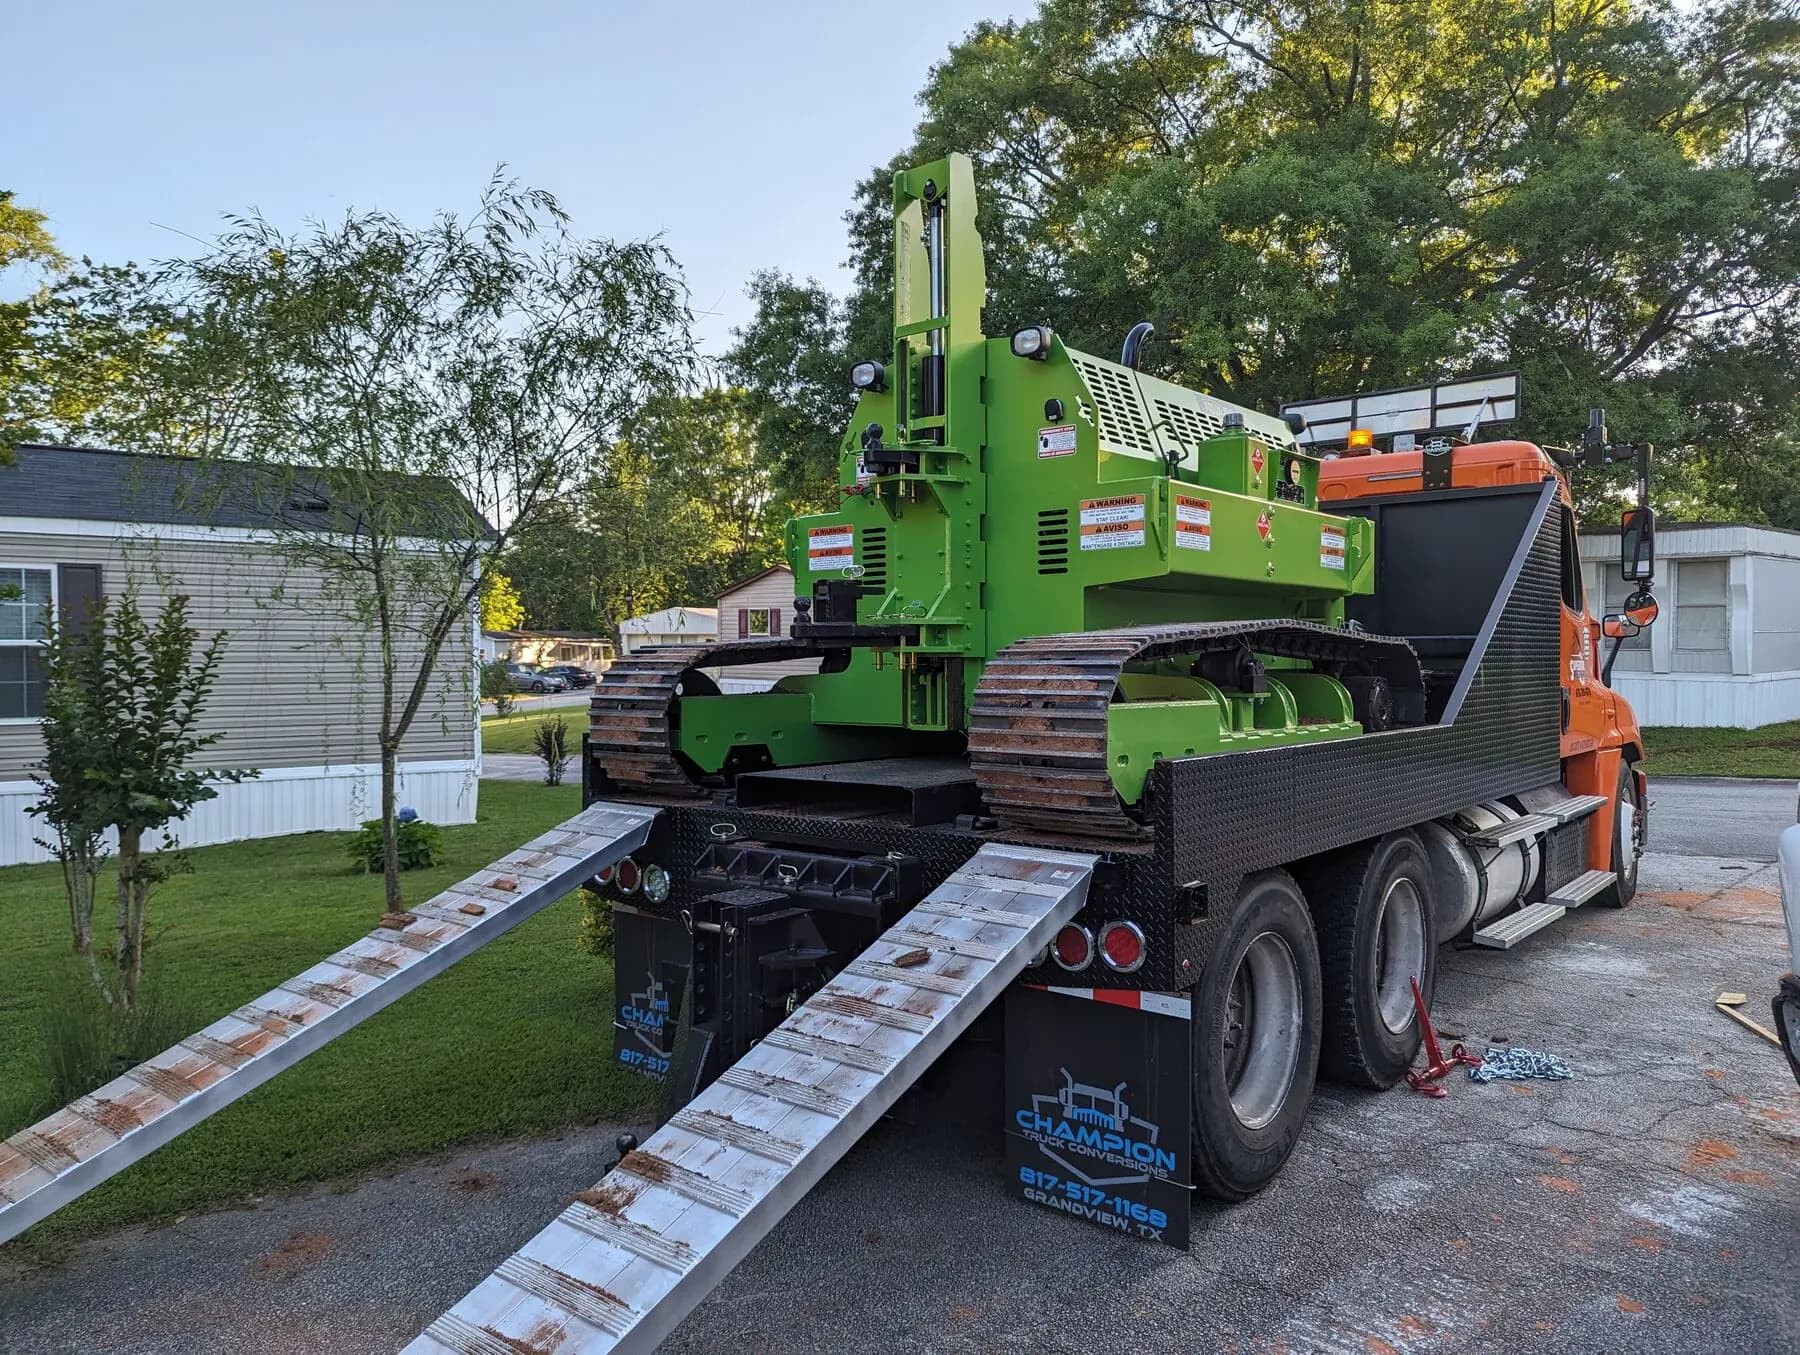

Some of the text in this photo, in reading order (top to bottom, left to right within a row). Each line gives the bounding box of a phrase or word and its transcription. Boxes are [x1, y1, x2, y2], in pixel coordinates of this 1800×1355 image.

[1096, 497, 1137, 508] WARNING
[1103, 523, 1129, 532] AVISO
[1015, 1109, 1176, 1172] CHAMPION
[1022, 1128, 1169, 1179] TRUCK CONVERSIONS
[1019, 1166, 1168, 1229] 817-517-1168
[1136, 1223, 1164, 1242] TX
